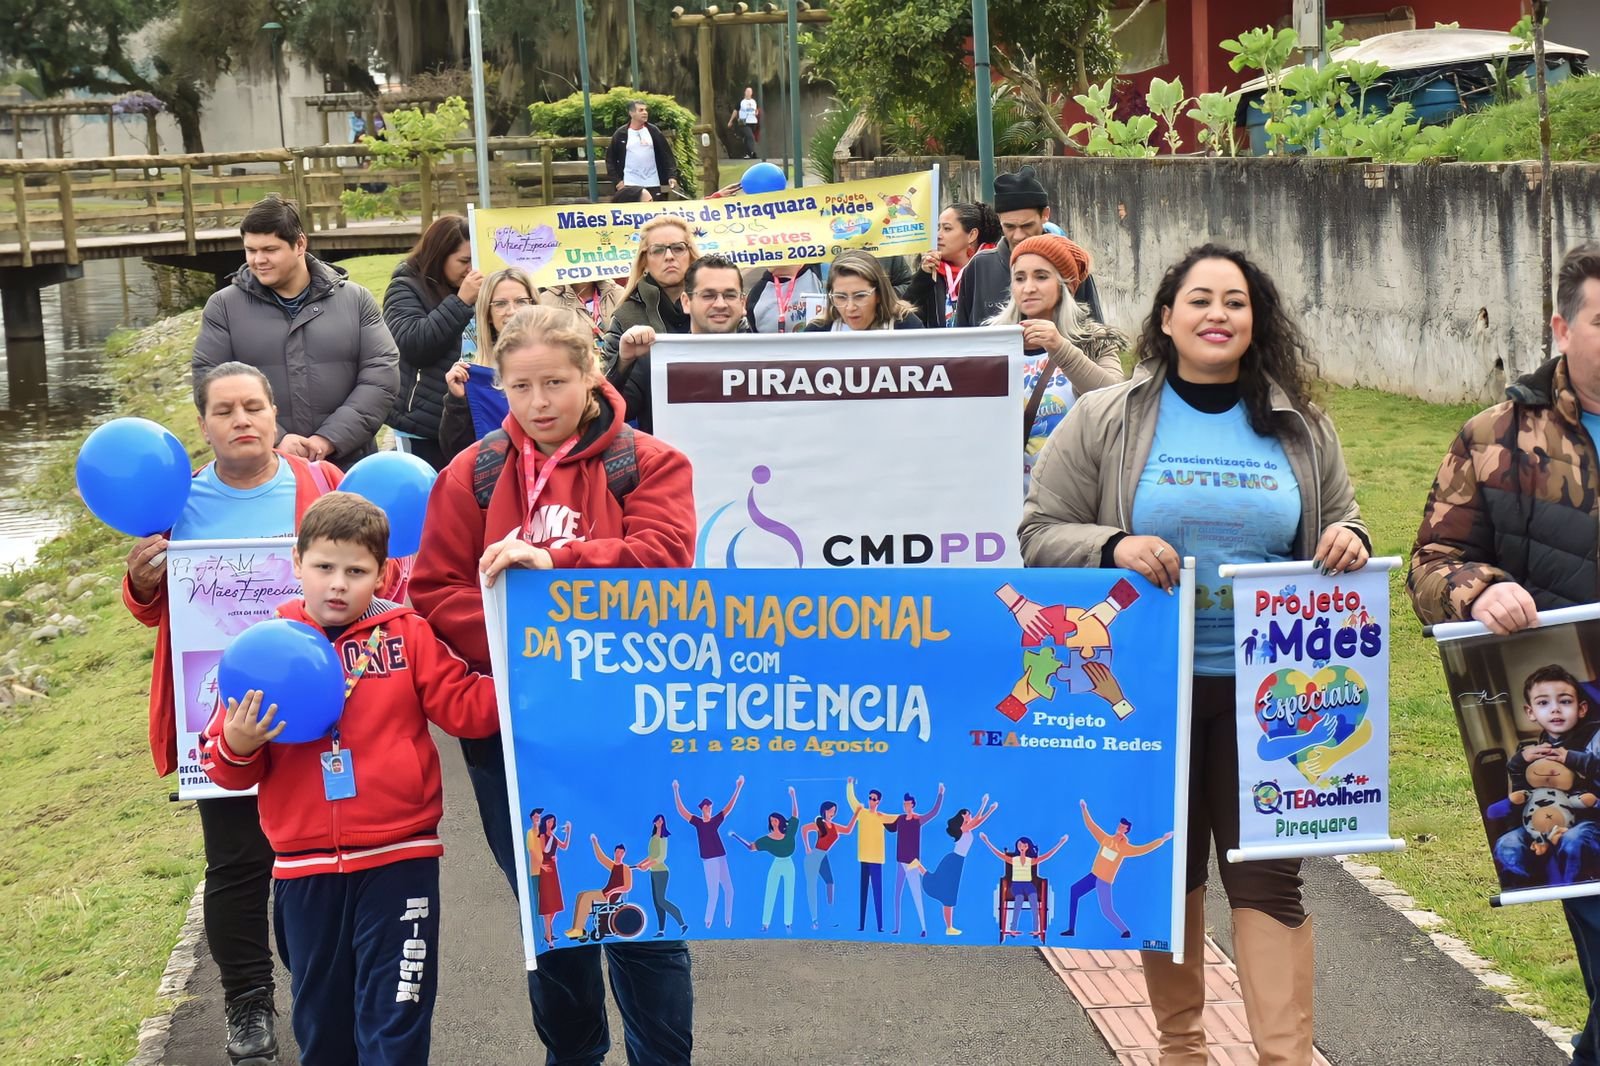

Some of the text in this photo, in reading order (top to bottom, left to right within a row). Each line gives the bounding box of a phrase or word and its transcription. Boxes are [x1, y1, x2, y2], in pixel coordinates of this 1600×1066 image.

[557, 196, 818, 230] Mães Espeis de Piraquara
[746, 232, 812, 246] Fortes
[787, 245, 826, 260] 2023
[556, 267, 592, 279] PCD
[722, 364, 953, 396] PIRAQUARA
[1158, 454, 1278, 471] Conscientização do
[1156, 469, 1279, 491] AUTISMO
[531, 505, 582, 544] NIKE
[822, 532, 1006, 566] CMDPD
[178, 578, 239, 606] Mães
[1255, 587, 1361, 620] Projeto
[548, 580, 951, 648] SEMANA NACIONAL
[522, 627, 562, 662] DA
[566, 629, 722, 681] PESSOA
[1268, 616, 1382, 664] Mães
[629, 675, 931, 742] DEFICIÊNCIA
[1258, 681, 1364, 729] Especiais
[1033, 711, 1106, 730] Projeto
[671, 736, 890, 757] 21 a 28 de Agosto
[969, 730, 1162, 751] TEAtecendo Redes
[1275, 816, 1358, 839] Piraquara
